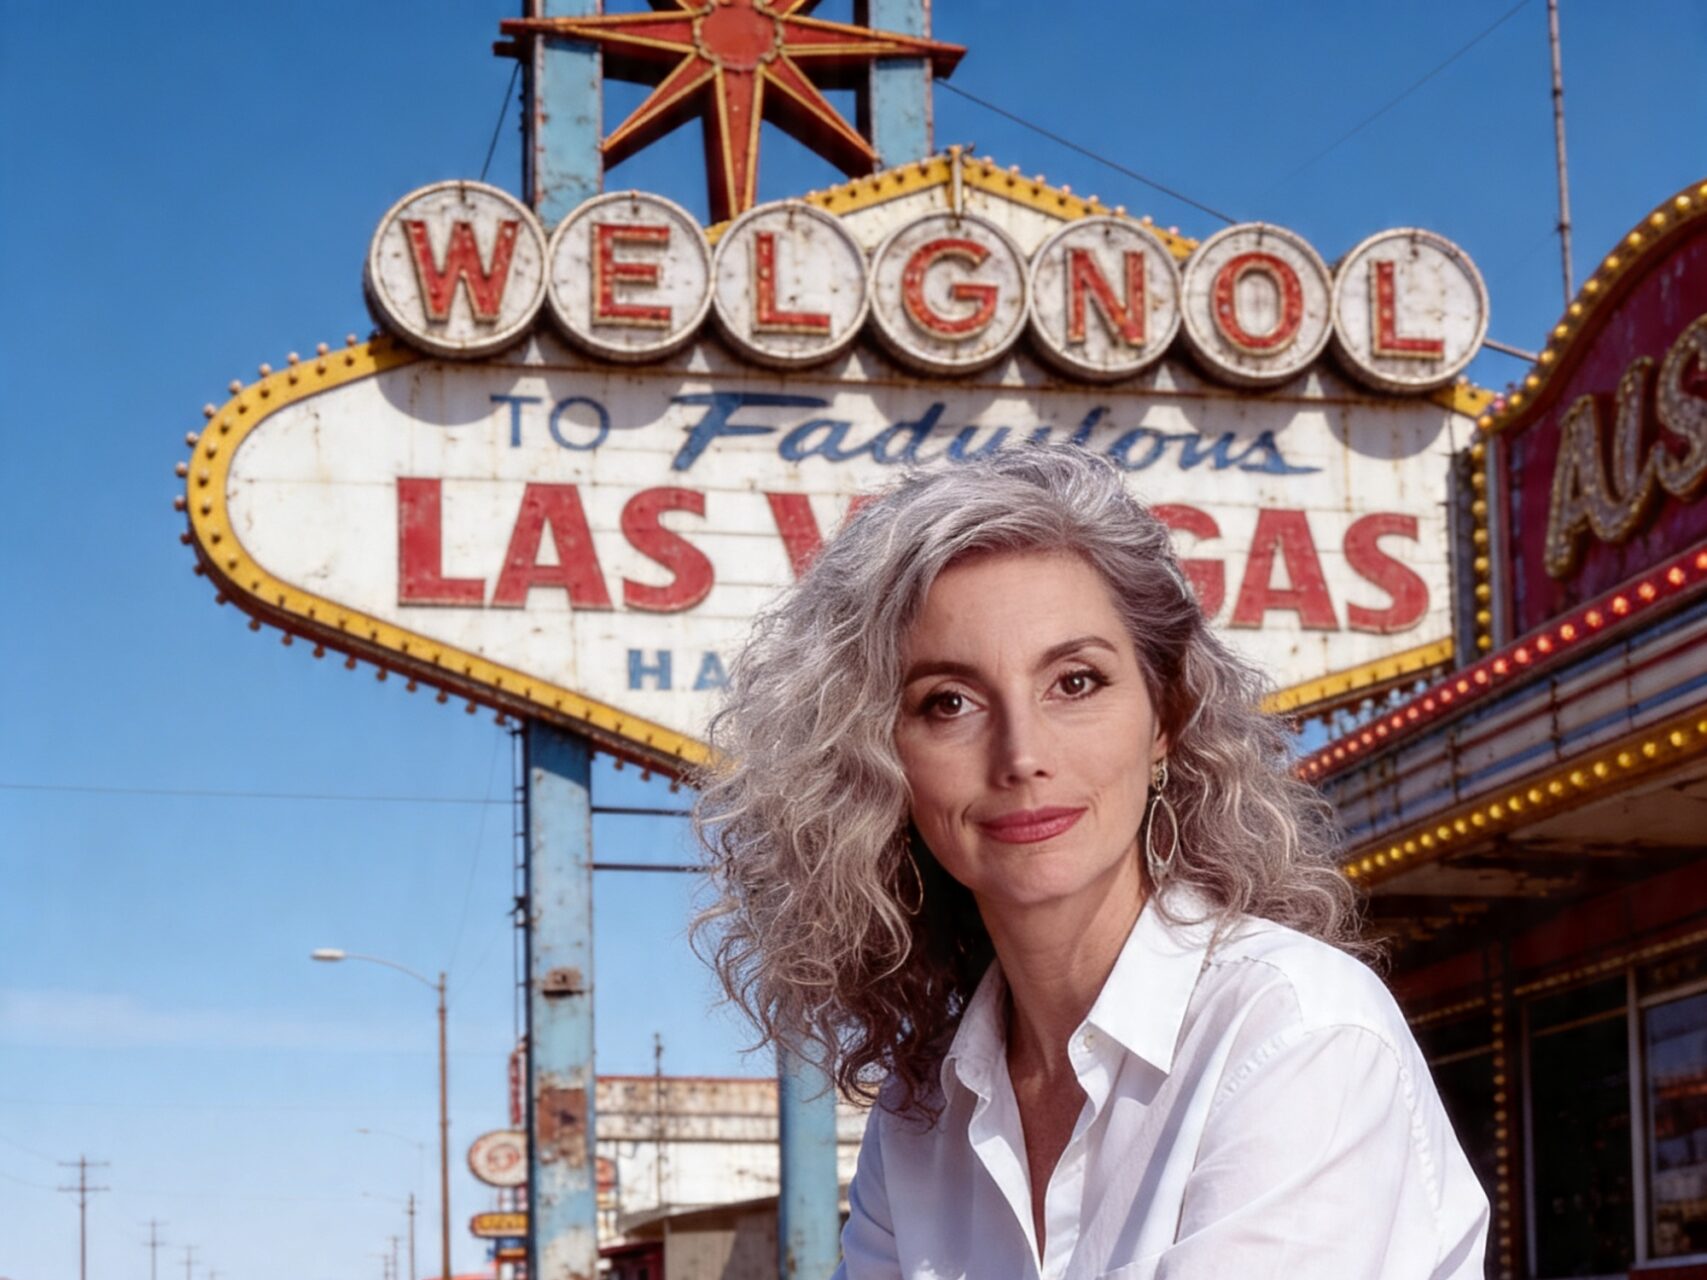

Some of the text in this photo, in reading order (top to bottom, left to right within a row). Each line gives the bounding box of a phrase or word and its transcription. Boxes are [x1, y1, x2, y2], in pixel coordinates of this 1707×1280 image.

[403, 219, 1446, 361] WELGNOL
[490, 394, 610, 451] TO
[396, 475, 1430, 635] LAS VGAS
